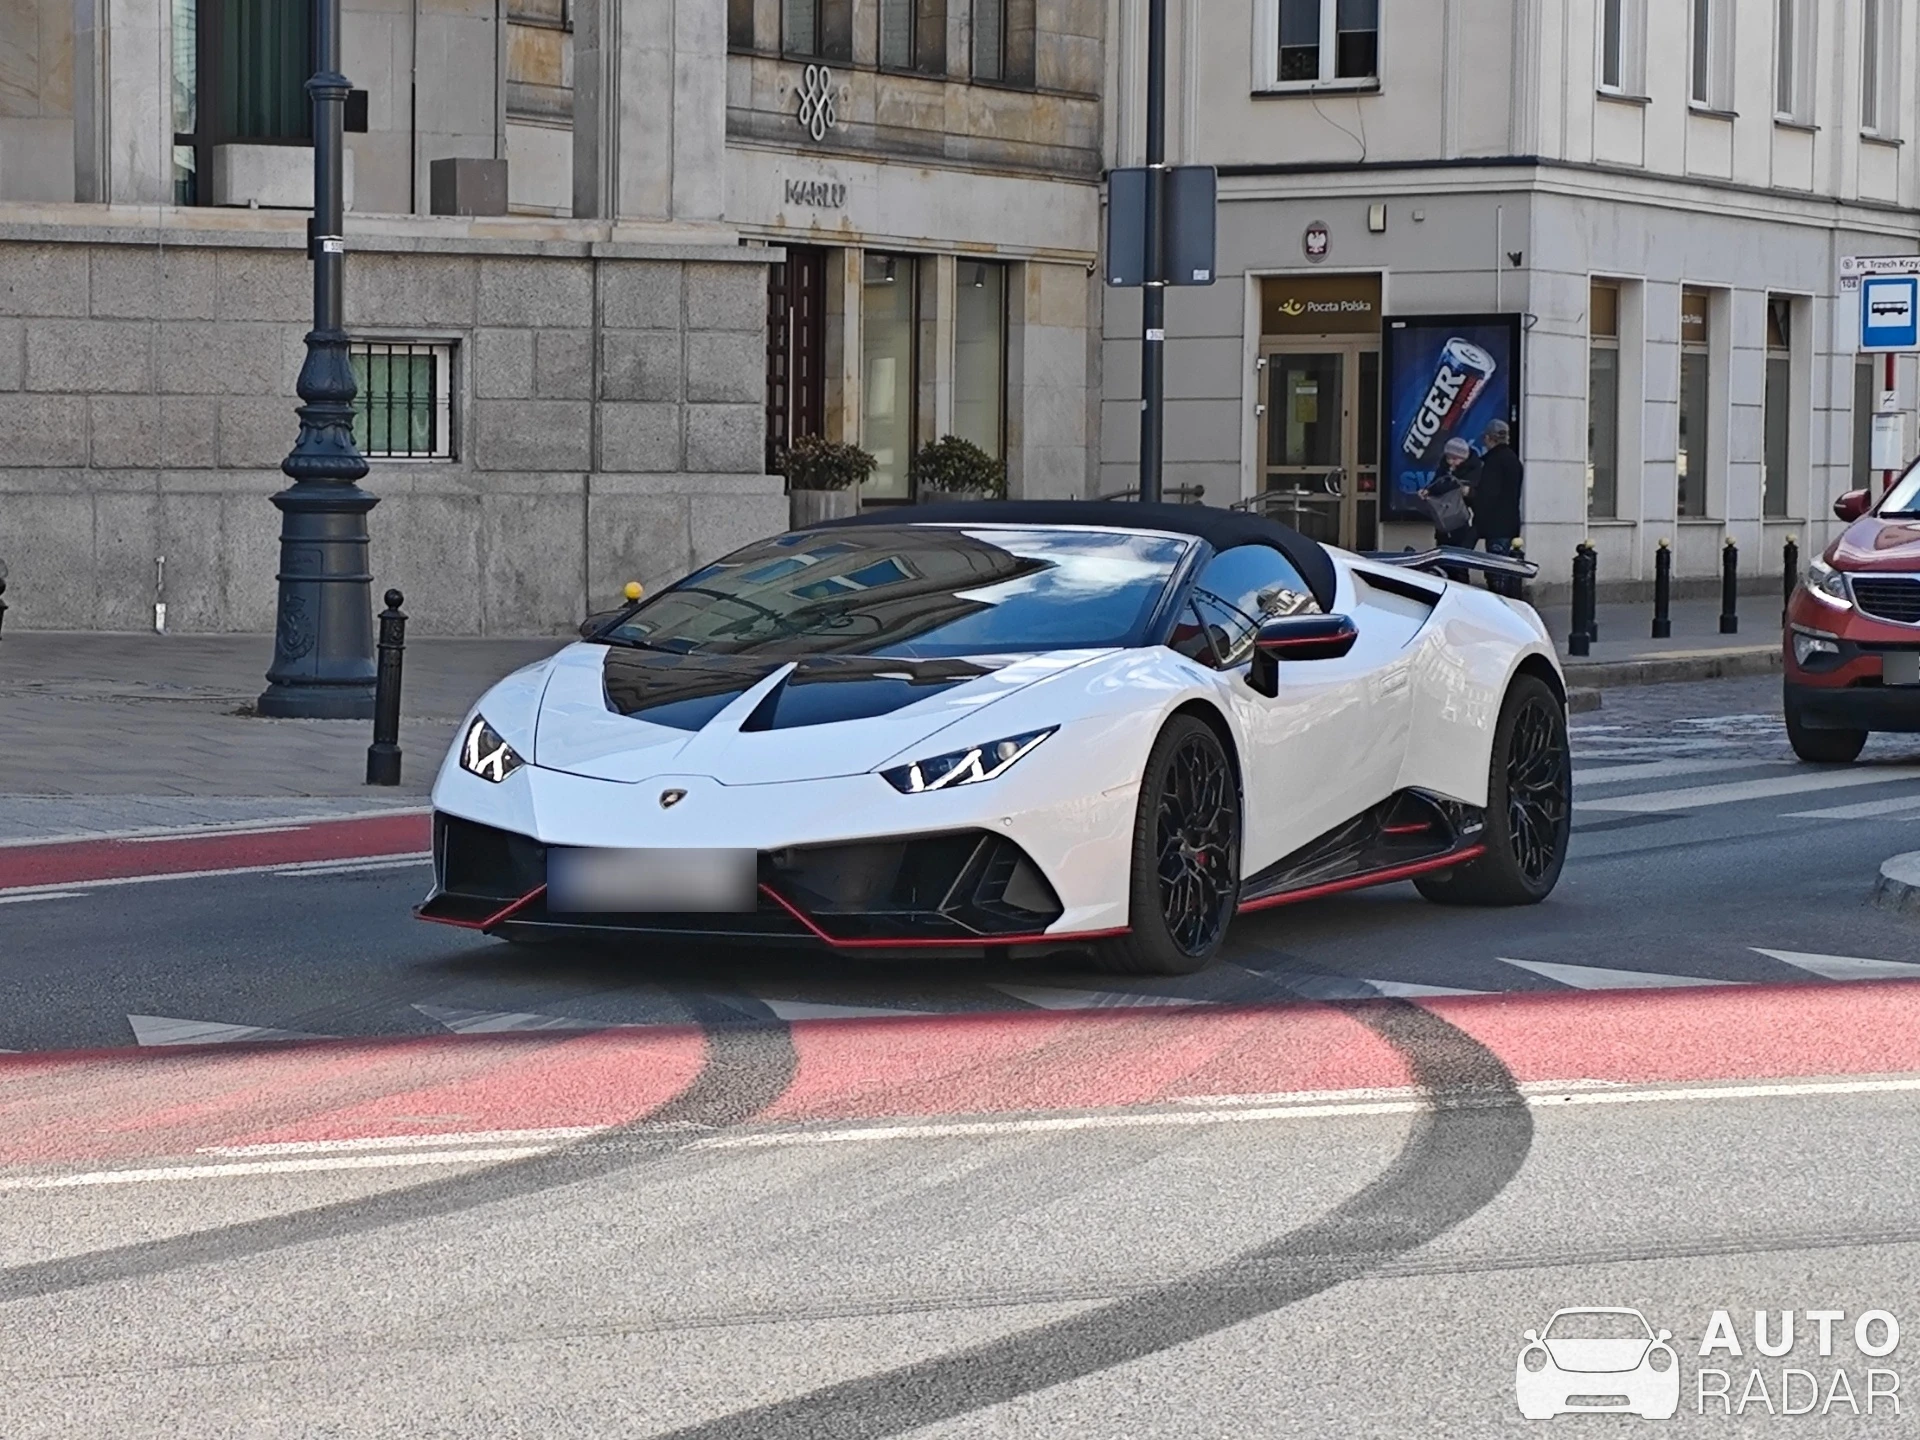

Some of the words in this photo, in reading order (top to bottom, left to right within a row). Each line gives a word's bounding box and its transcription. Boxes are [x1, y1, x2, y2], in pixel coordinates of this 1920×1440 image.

[785, 179, 846, 208] MARLU
[1870, 259, 1897, 269] Trzech
[1899, 259, 1920, 271] Krzy
[1307, 301, 1339, 312] Poczta
[1341, 300, 1372, 311] Polska
[1403, 365, 1467, 460] TIGER
